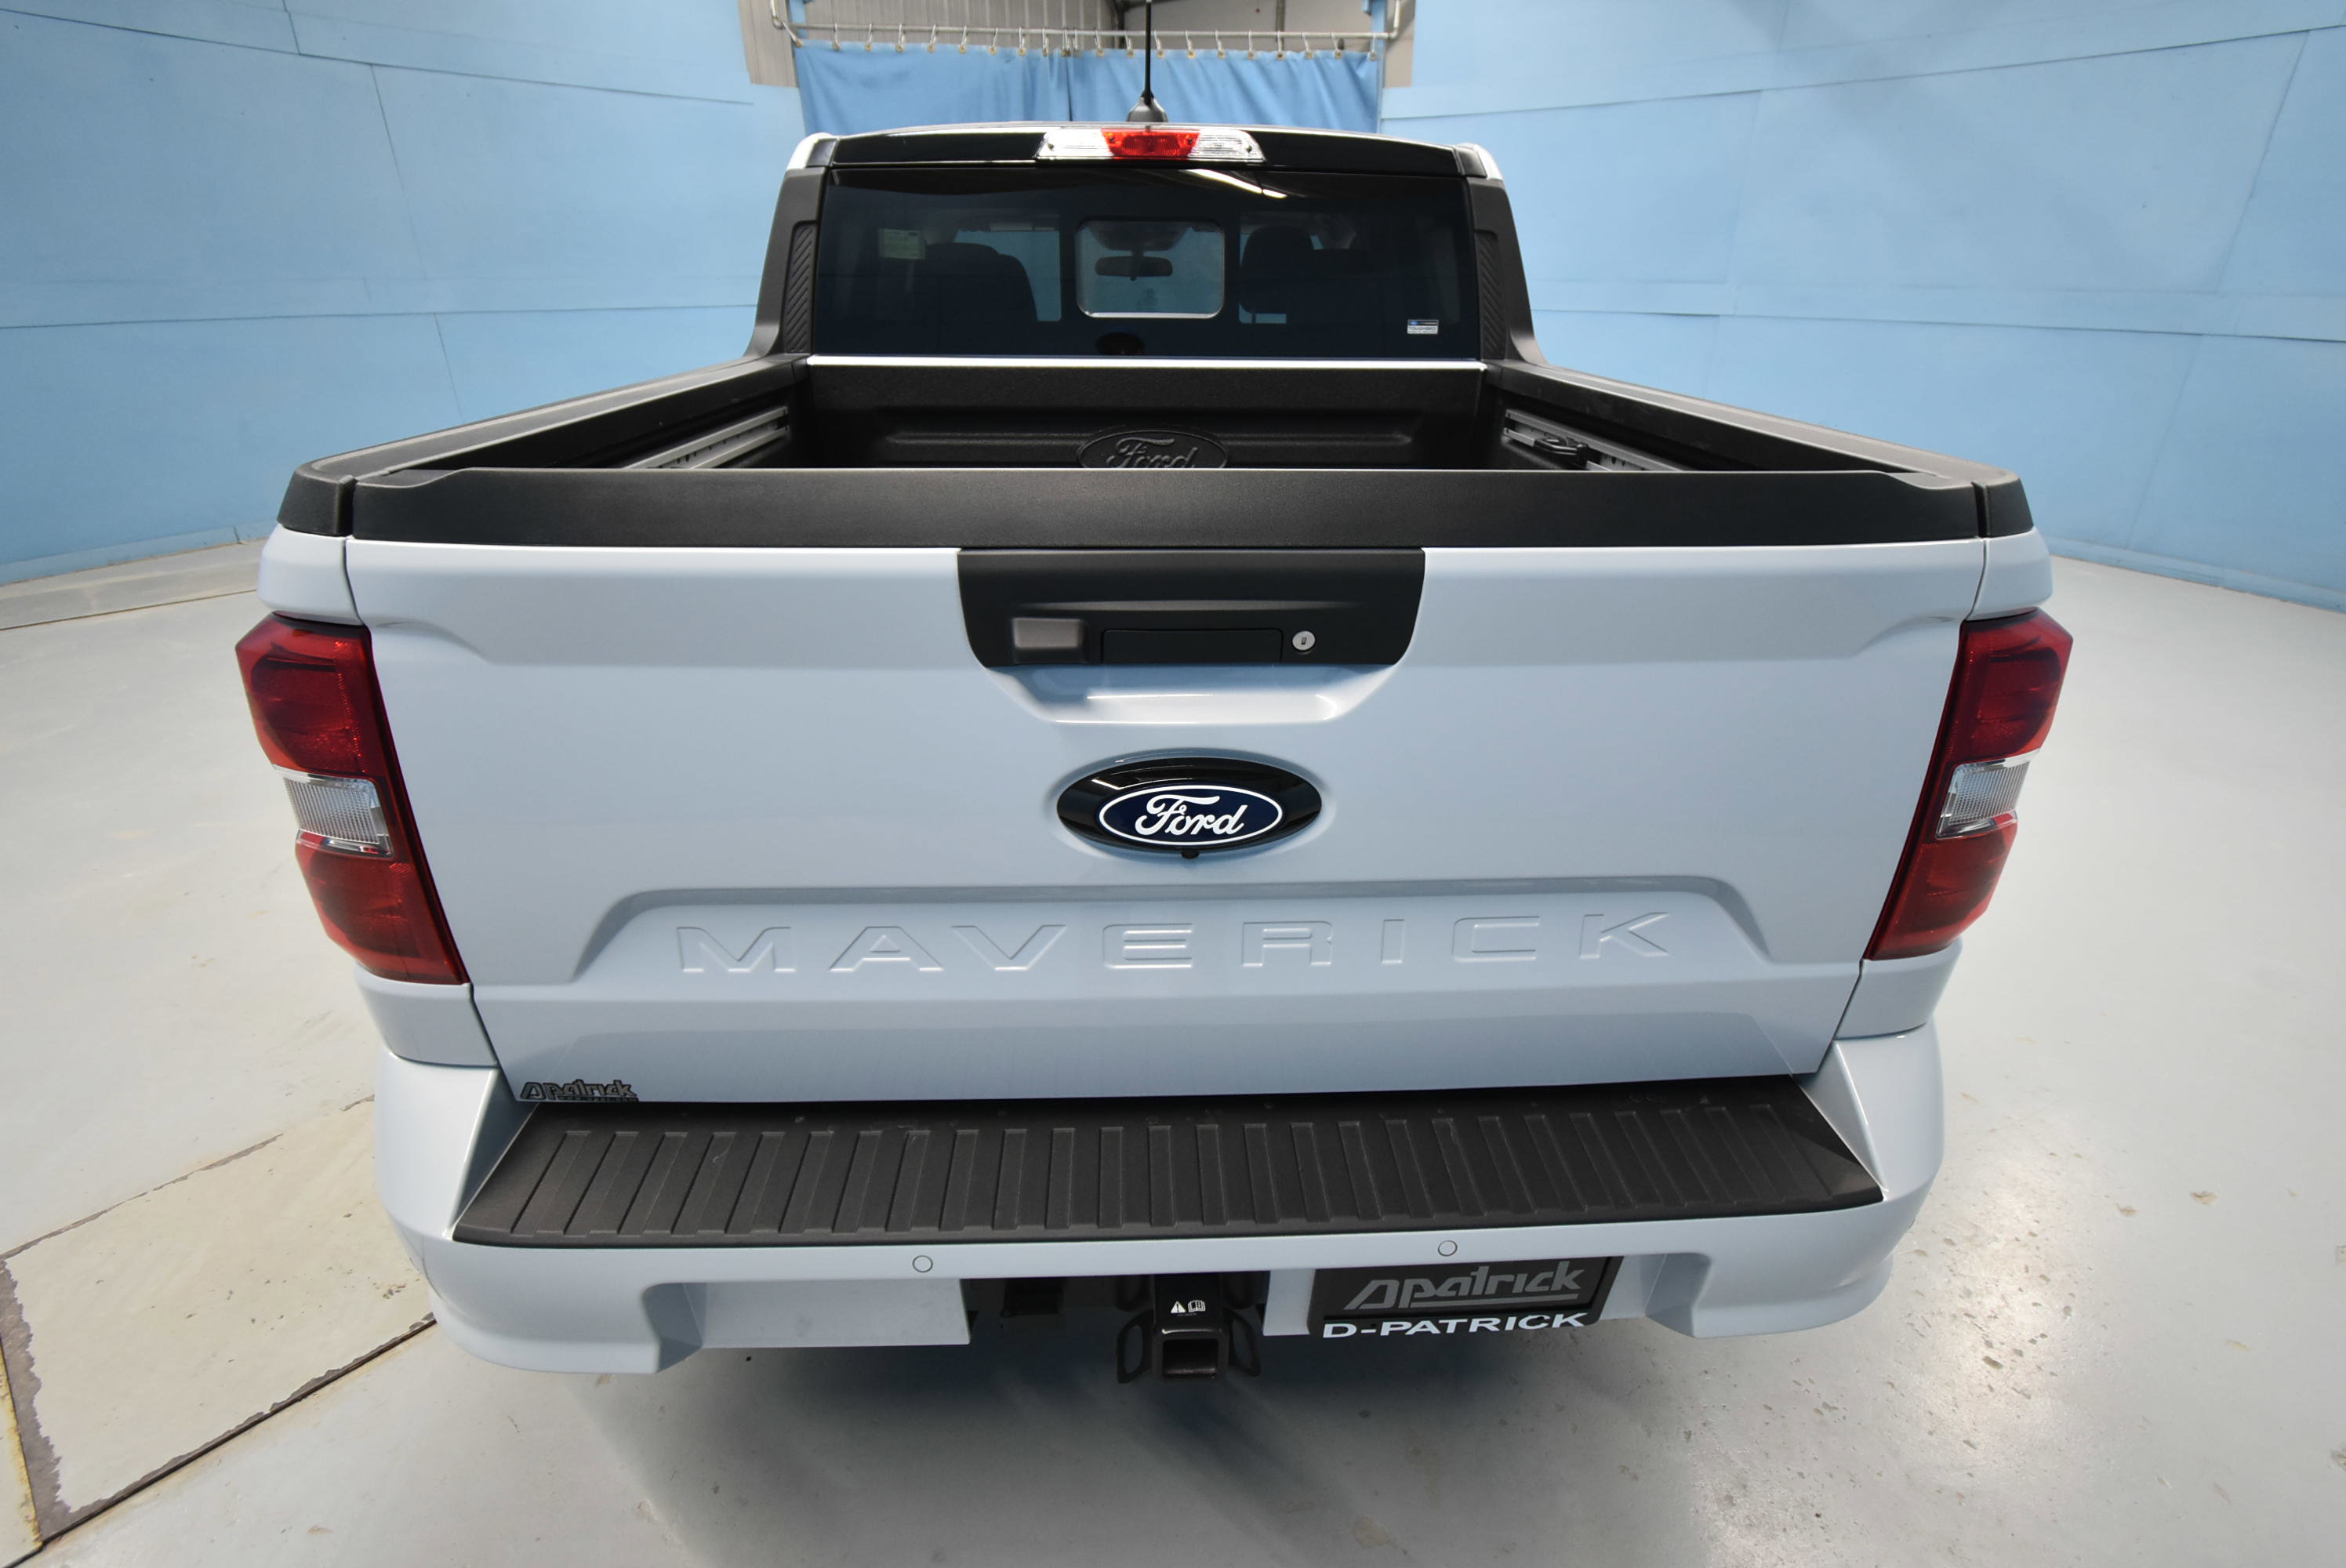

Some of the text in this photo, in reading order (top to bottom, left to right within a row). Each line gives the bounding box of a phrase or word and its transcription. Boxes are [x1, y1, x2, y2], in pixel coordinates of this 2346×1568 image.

[1106, 437, 1199, 468] Ford
[1135, 793, 1248, 836] Ford
[675, 911, 1671, 974] MAVERICK
[1323, 1312, 1588, 1338] D-PATRICK
